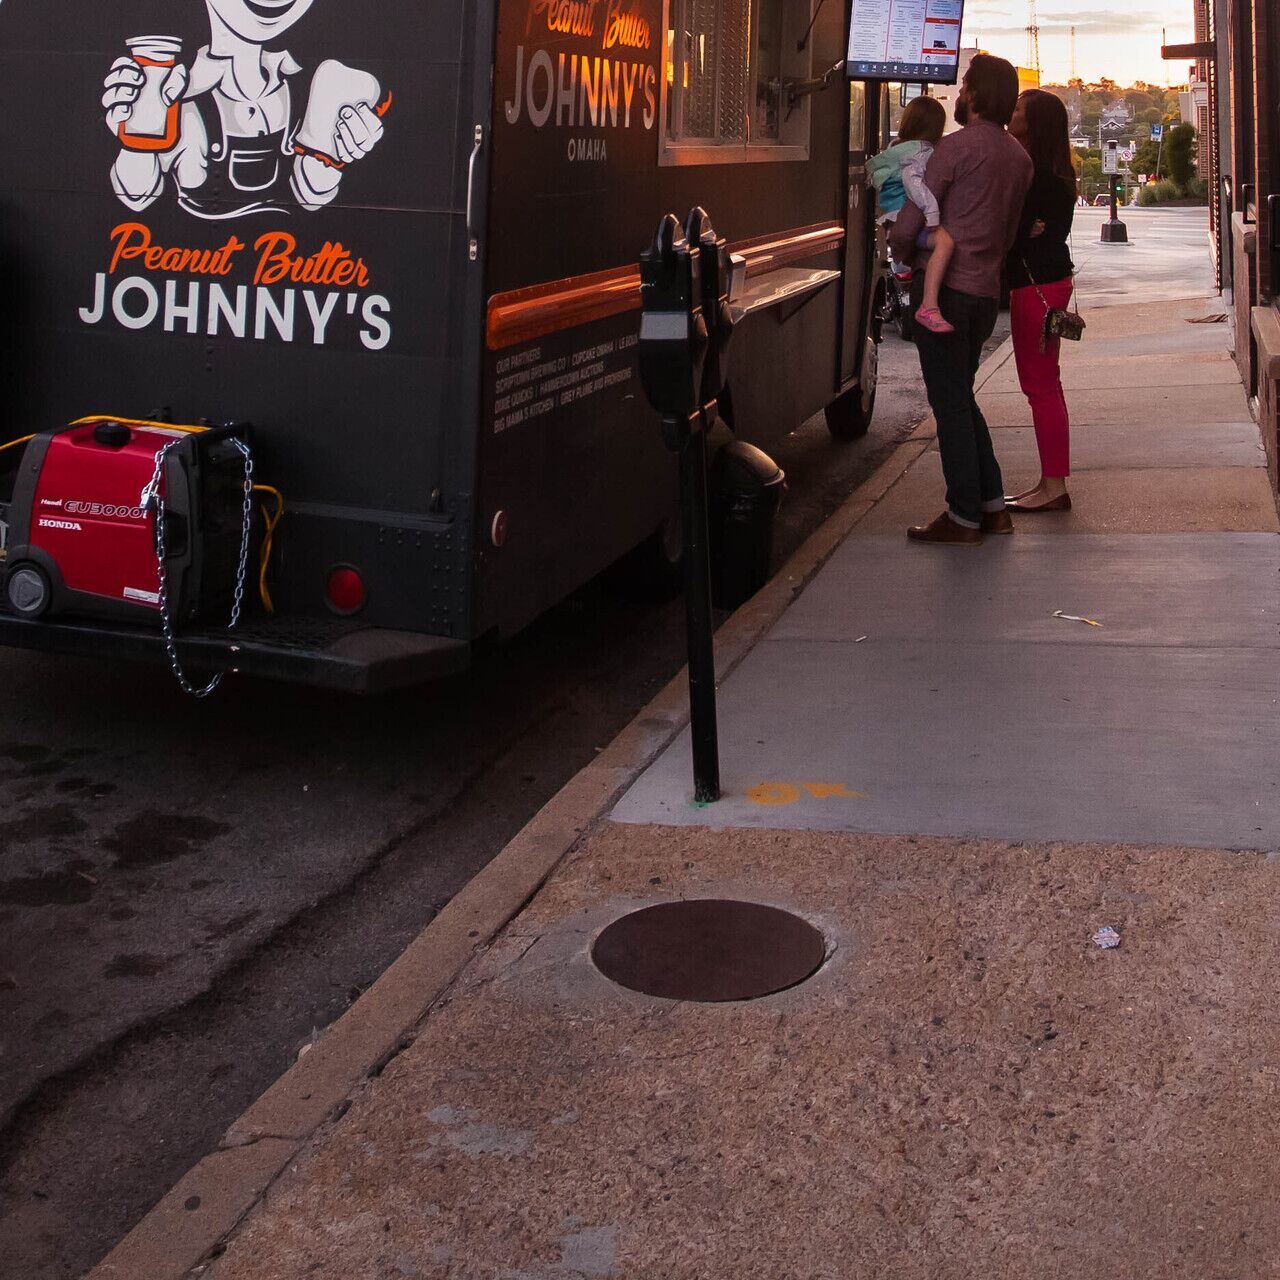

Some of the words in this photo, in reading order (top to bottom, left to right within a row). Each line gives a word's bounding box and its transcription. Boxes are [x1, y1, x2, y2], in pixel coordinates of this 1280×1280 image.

[504, 45, 656, 130] JOHNNY'S
[568, 138, 607, 161] OMAHA
[109, 222, 245, 276] Peanut
[253, 231, 370, 287] Butter
[78, 272, 391, 350] JOHNNY'S
[38, 519, 82, 531] HONDA
